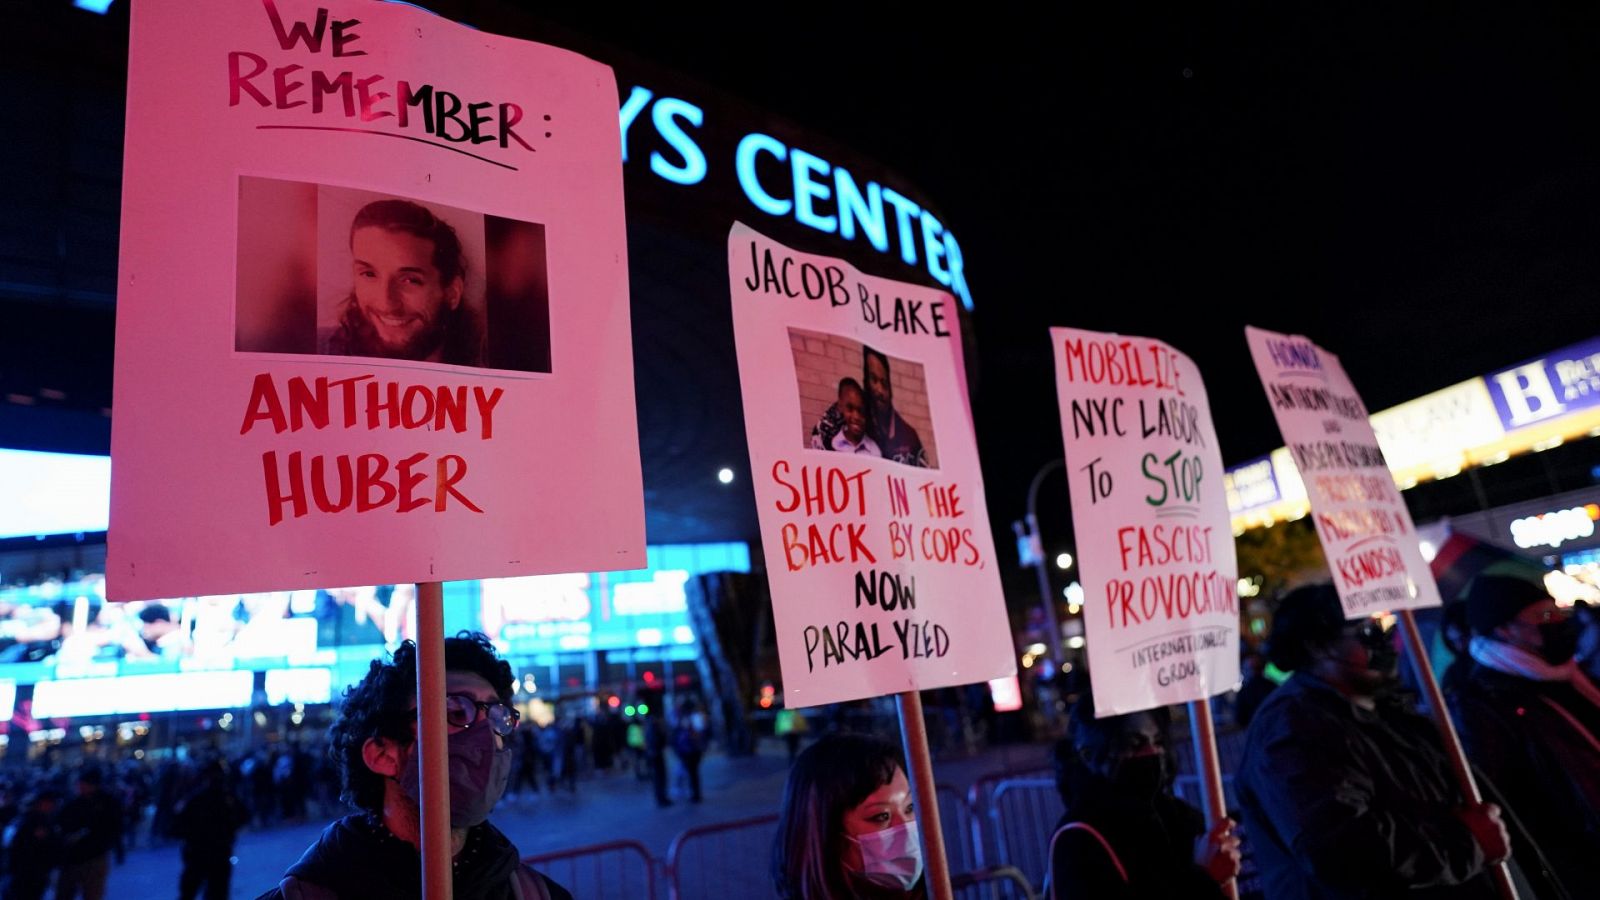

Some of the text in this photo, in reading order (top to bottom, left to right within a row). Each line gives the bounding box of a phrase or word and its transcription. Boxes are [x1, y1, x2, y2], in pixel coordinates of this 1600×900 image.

[262, 0, 368, 58] WE
[735, 132, 974, 311] CENTER
[745, 241, 951, 338] JACOB BLAKE
[1065, 338, 1185, 397] MOBILIZE
[1493, 360, 1566, 427] B
[240, 373, 504, 440] ANTHONY
[1071, 397, 1206, 449] NYC LABOR
[262, 451, 484, 526] HUBER
[772, 460, 964, 518] SHOT IN THE
[1142, 449, 1203, 506] STOP
[781, 521, 984, 572] BACK BY COPS,
[1118, 524, 1213, 572] FASCIST
[855, 569, 916, 611] NOW
[803, 619, 950, 673] PARALYZED
